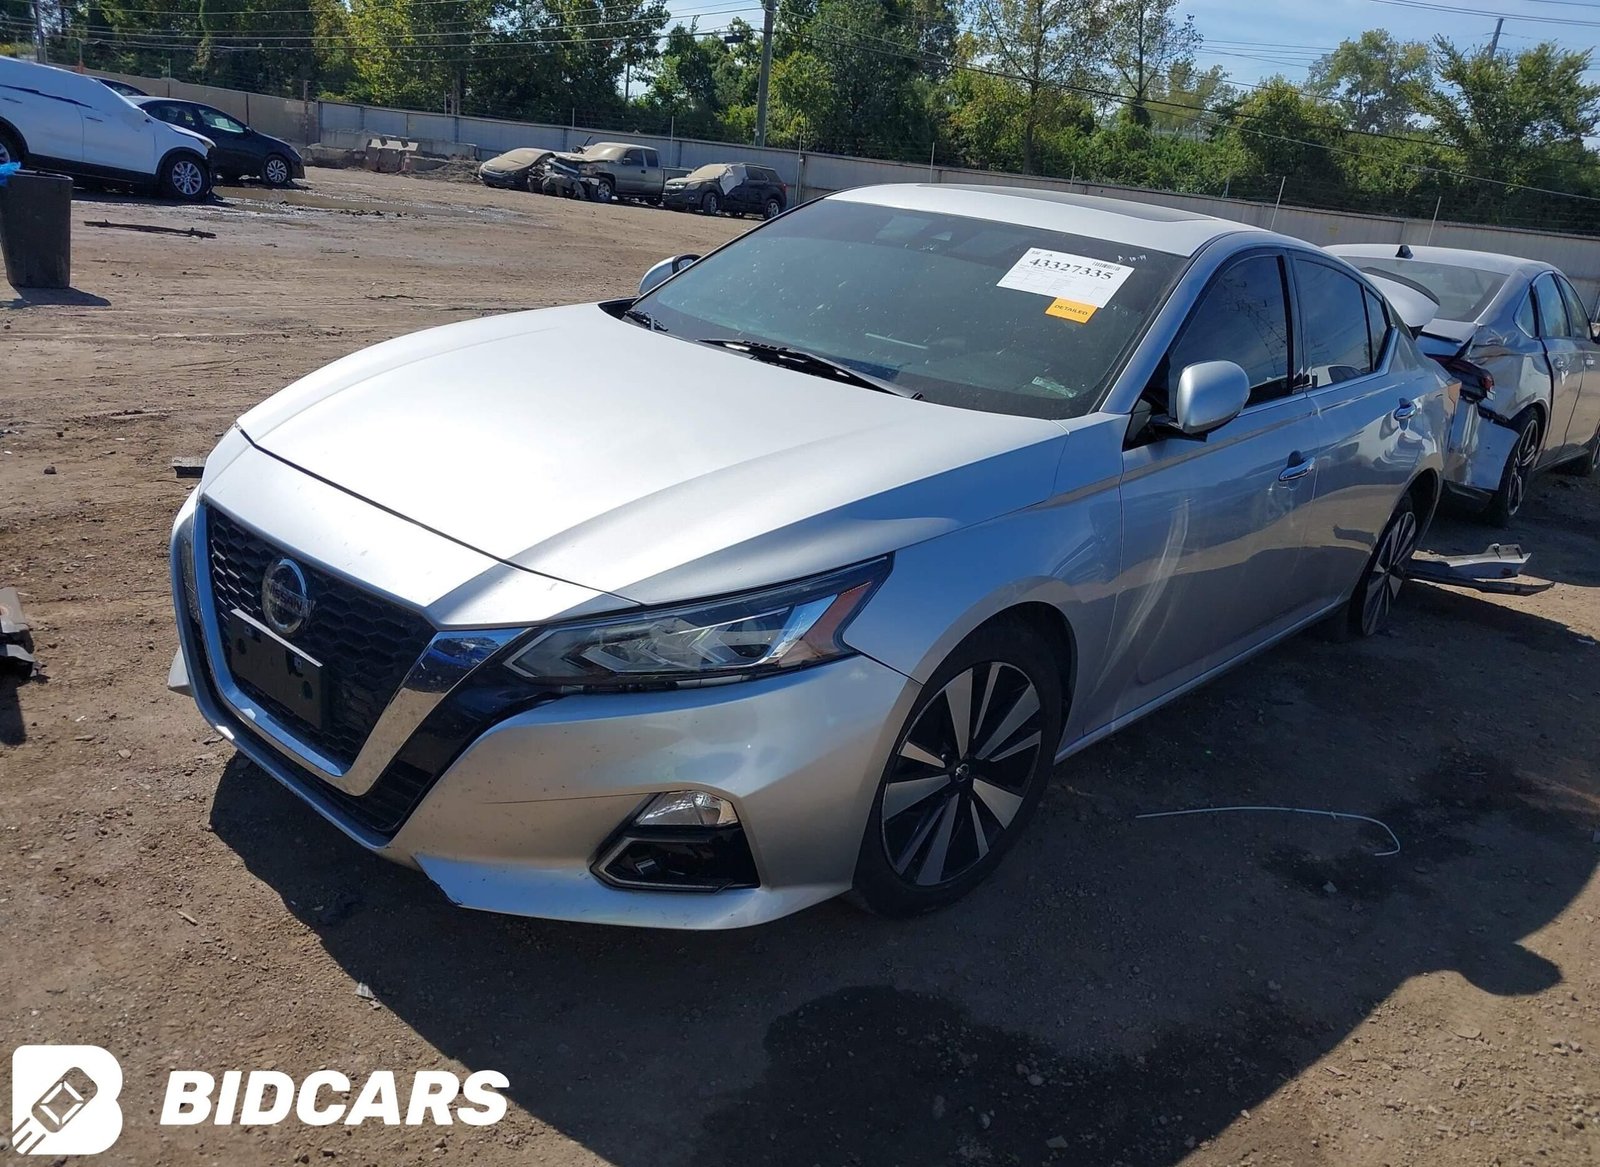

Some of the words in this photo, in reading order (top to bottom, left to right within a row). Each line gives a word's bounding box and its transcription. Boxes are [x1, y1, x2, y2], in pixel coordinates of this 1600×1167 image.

[1029, 258, 1115, 280] 43327335
[1054, 304, 1088, 316] DETAILED
[267, 582, 303, 611] NISSAN
